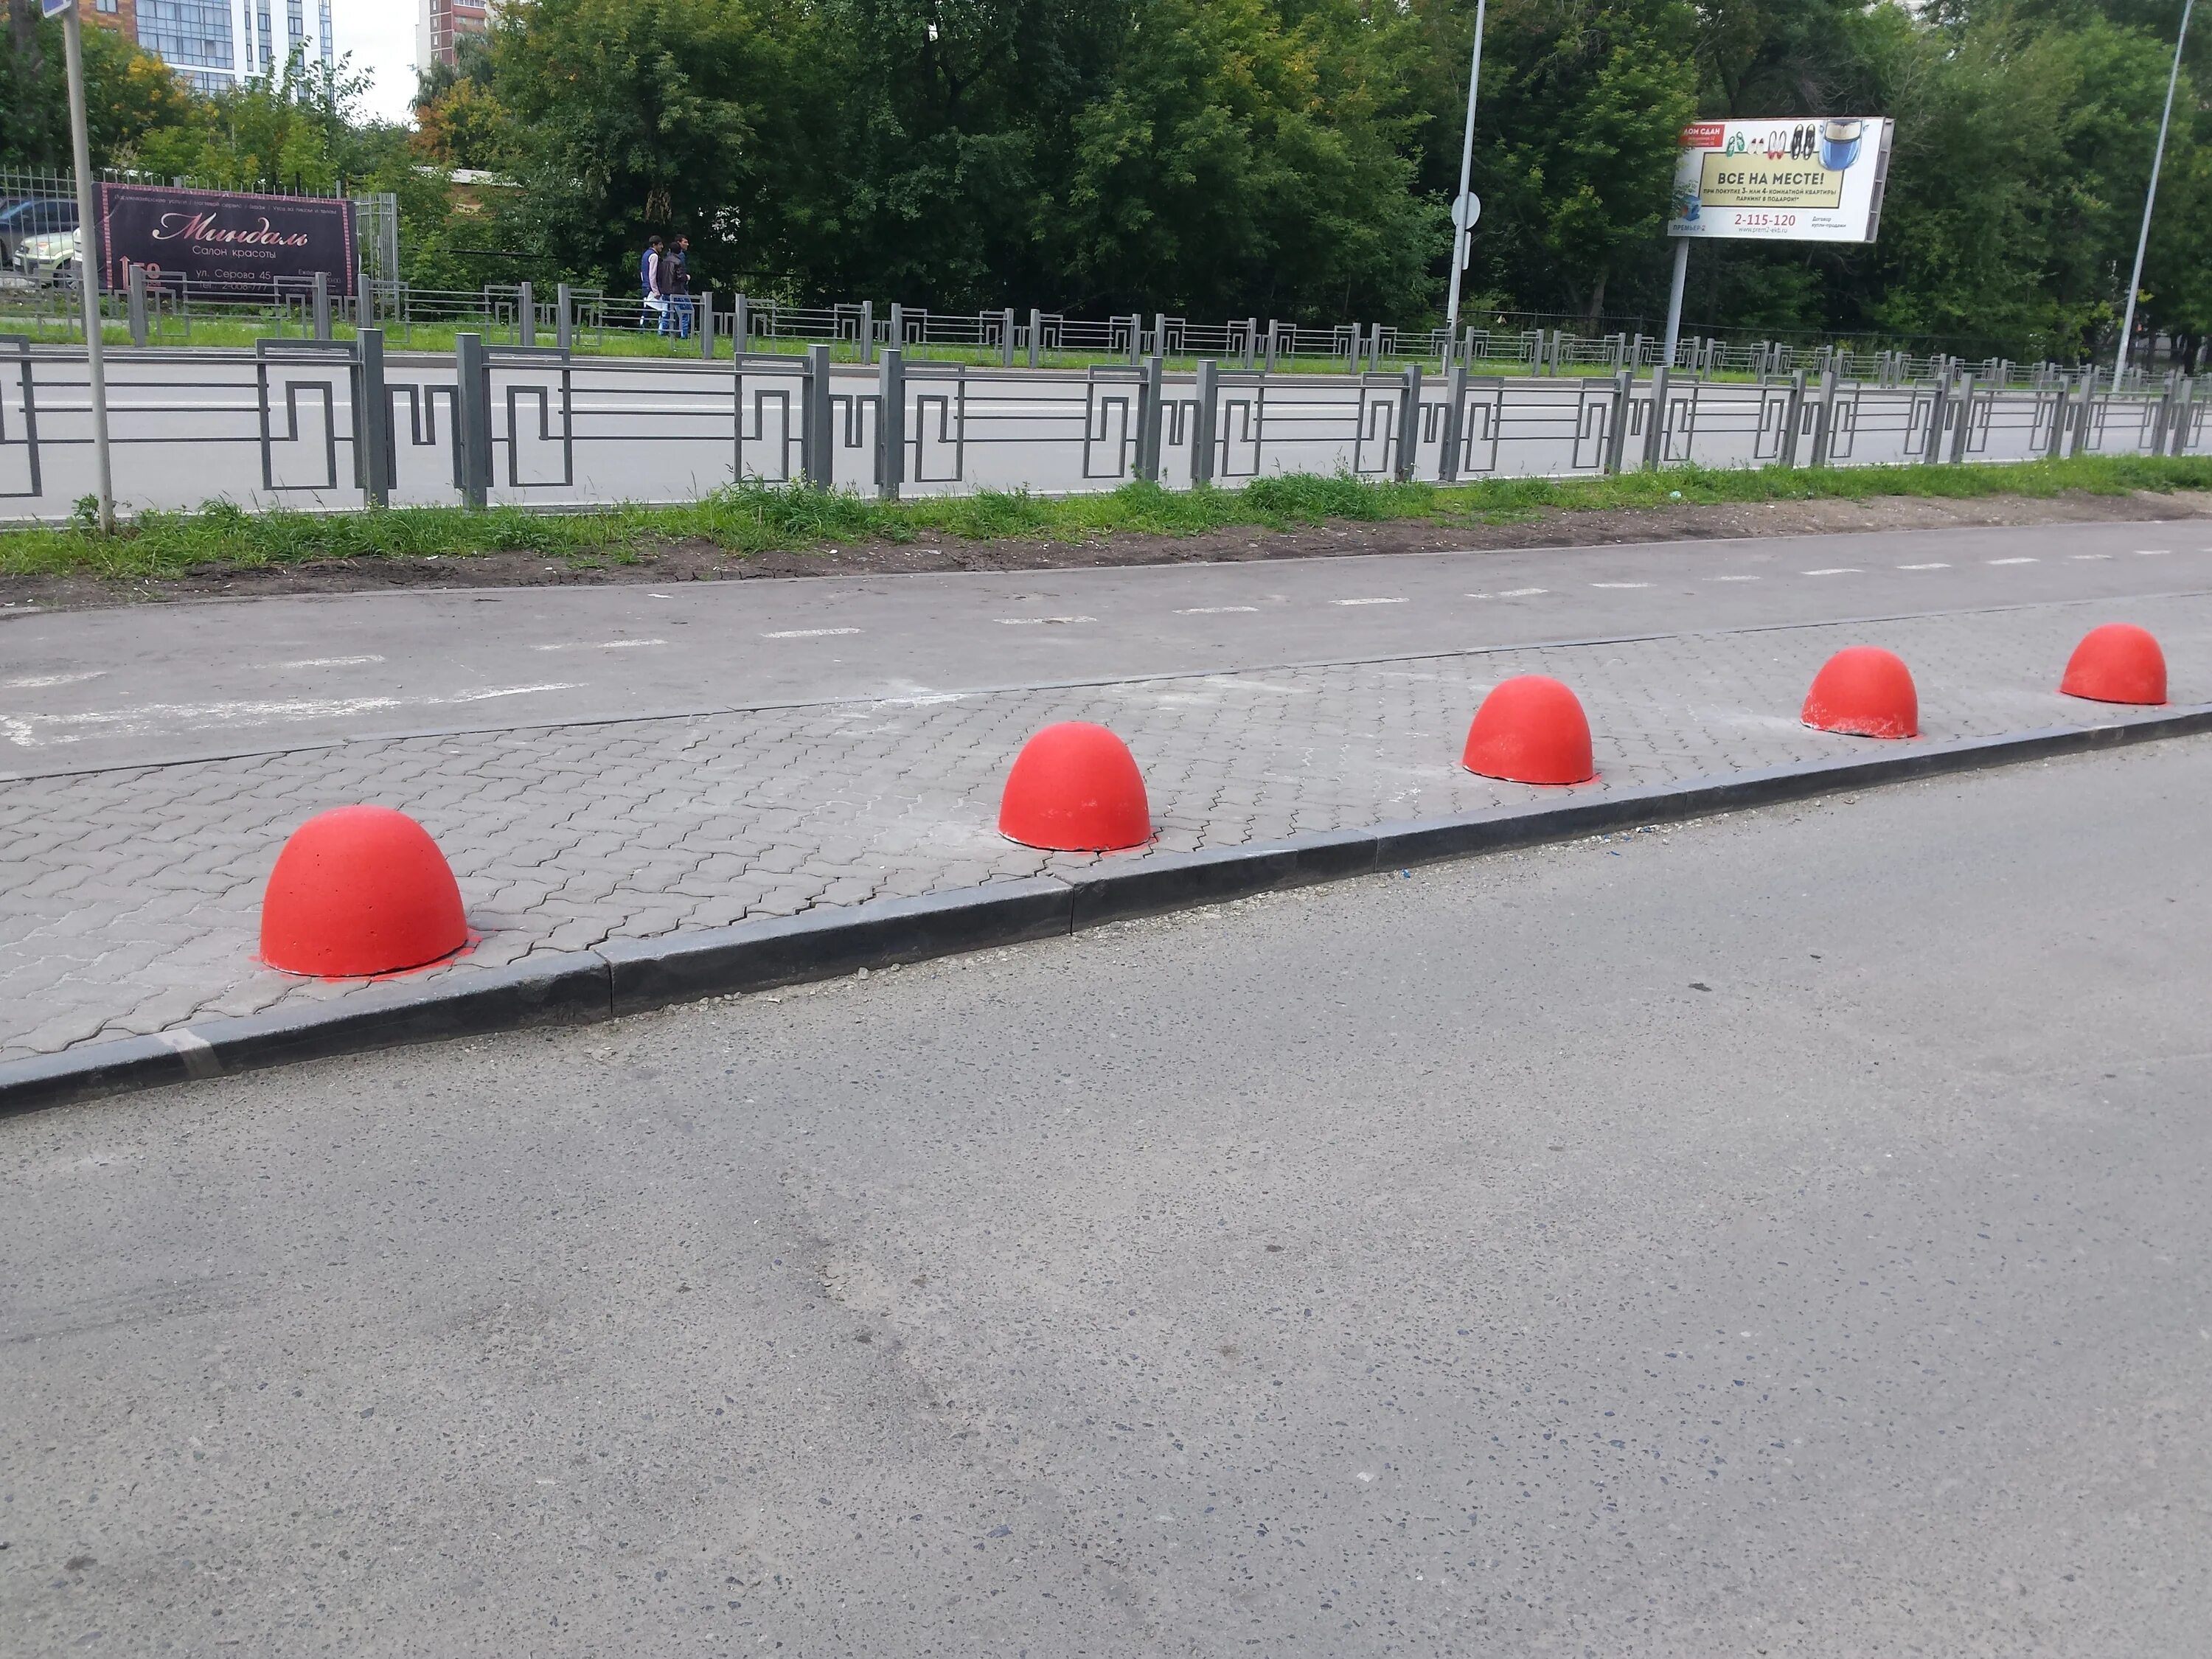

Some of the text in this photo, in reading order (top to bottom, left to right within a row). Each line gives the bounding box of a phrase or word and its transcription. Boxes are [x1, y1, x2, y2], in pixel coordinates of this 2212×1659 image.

[1700, 128, 1721, 136] СДАН
[1718, 173, 1825, 185] ВСЕ НА МЕСТЕ!
[1734, 214, 1795, 226] 2-115-120
[152, 212, 308, 246] Миндаль
[192, 245, 276, 259] Салон красоты
[195, 269, 271, 279] ул. Серова 45
